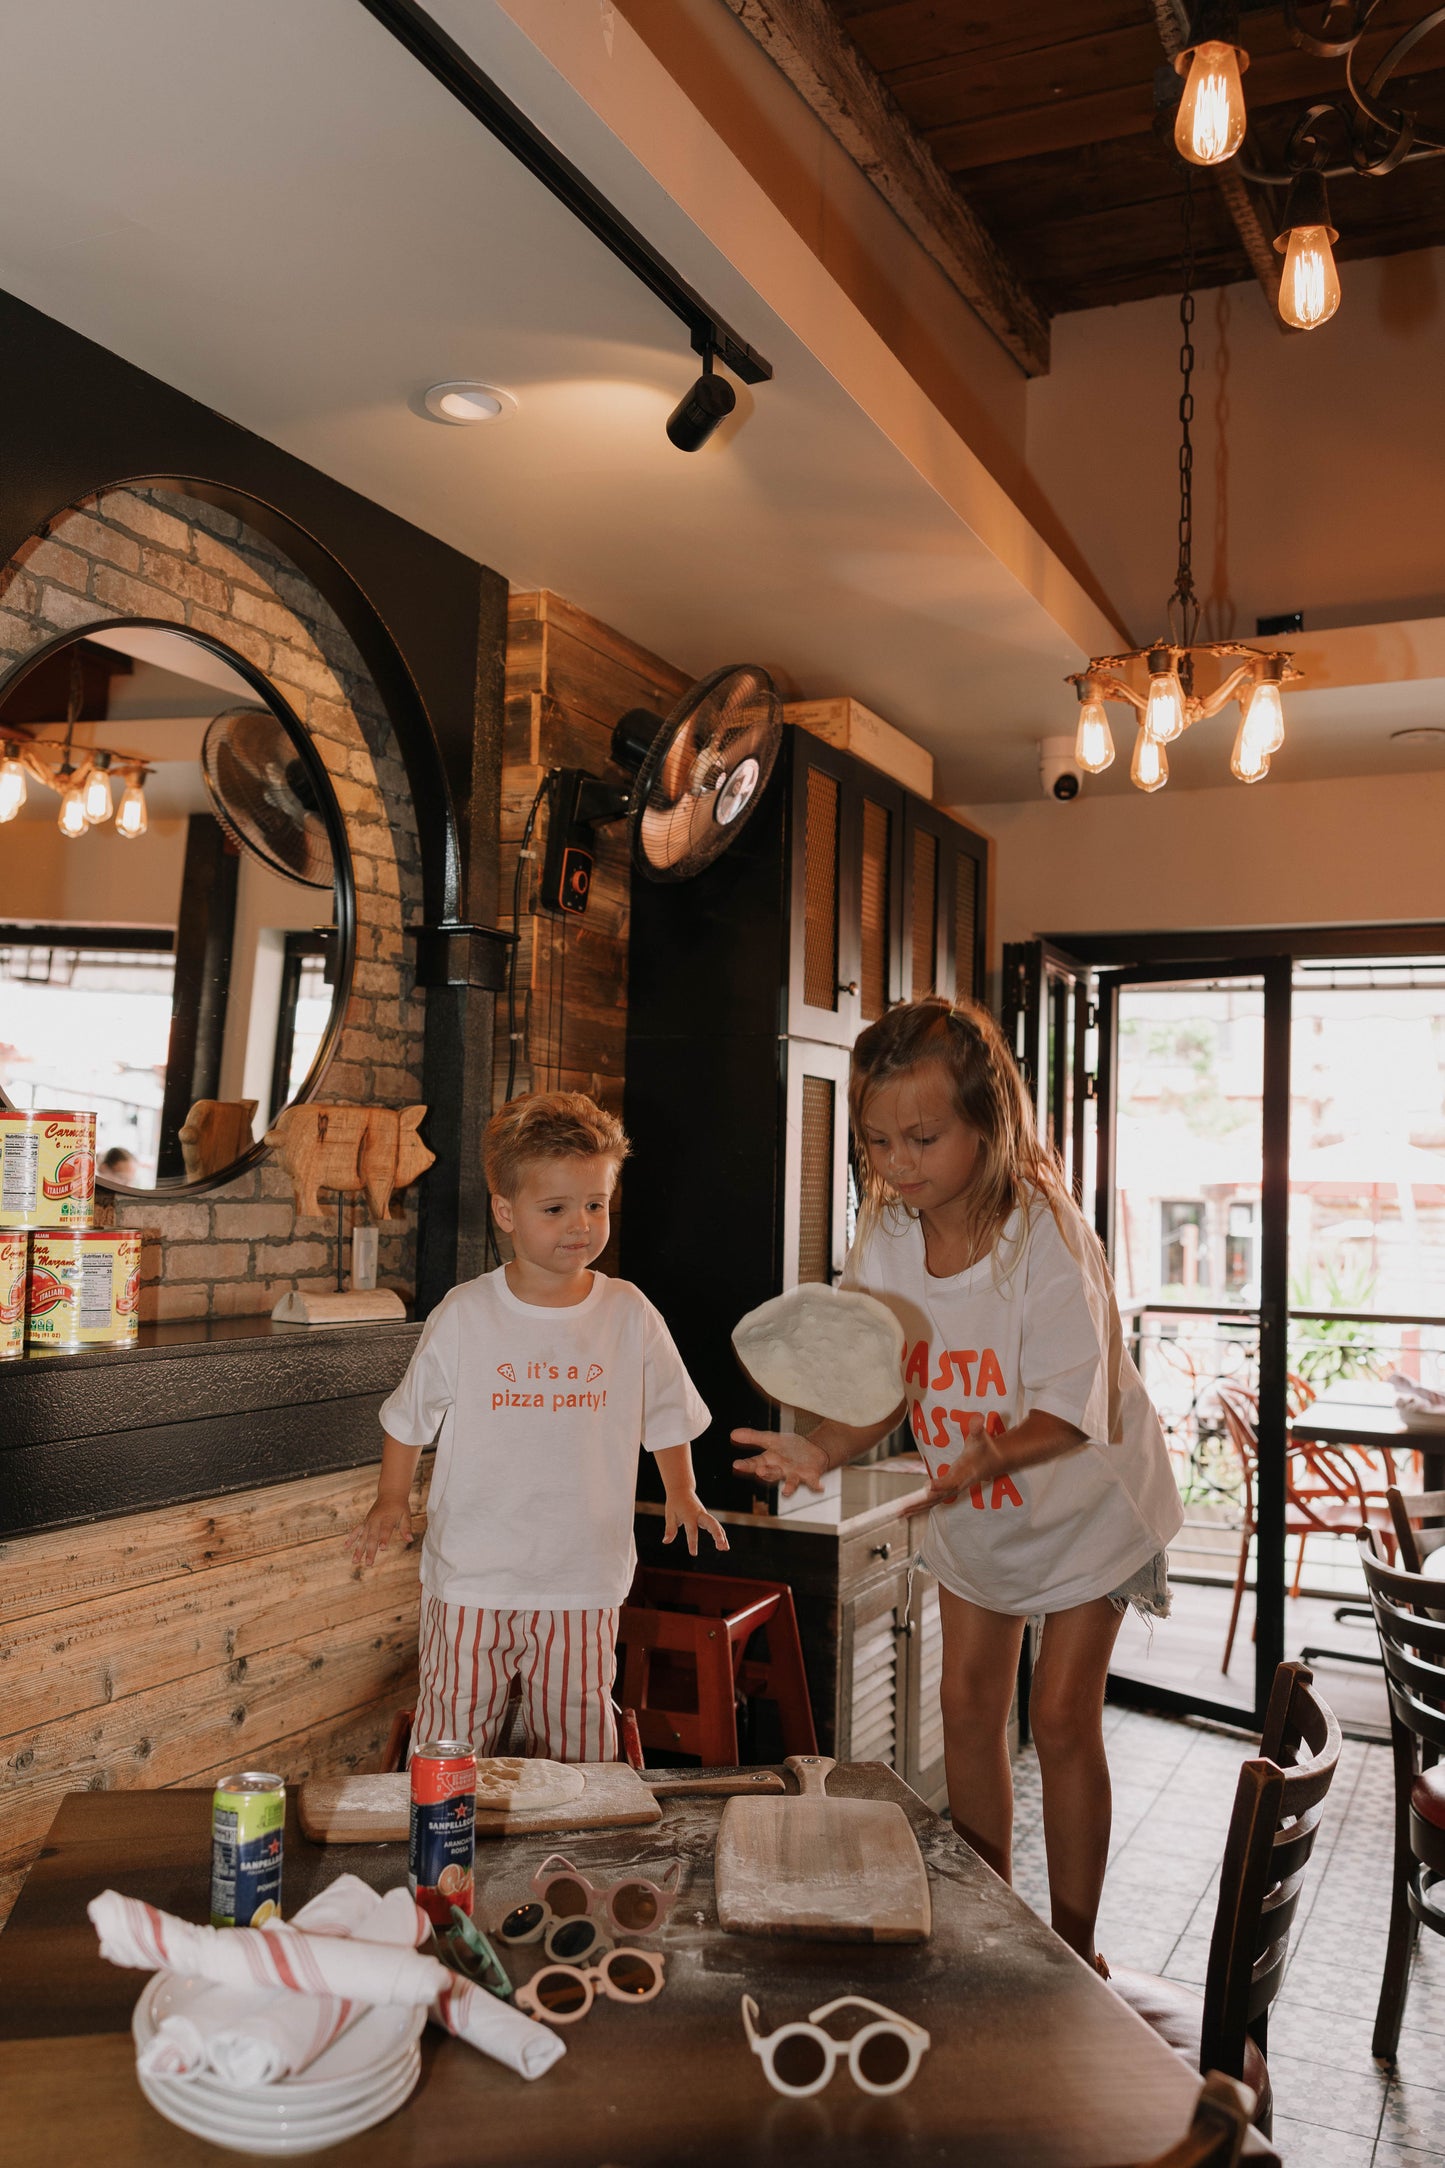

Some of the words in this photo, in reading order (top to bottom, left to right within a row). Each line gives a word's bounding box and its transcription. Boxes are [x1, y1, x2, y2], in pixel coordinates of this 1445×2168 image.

[47, 1185, 69, 1195] ITALIAN
[39, 1287, 65, 1302] ITALIANI
[567, 1365, 579, 1380] a
[902, 1340, 1007, 1397] ASTA
[491, 1389, 545, 1411] pizza
[552, 1389, 608, 1412] party!
[912, 1399, 1008, 1448] ASTA
